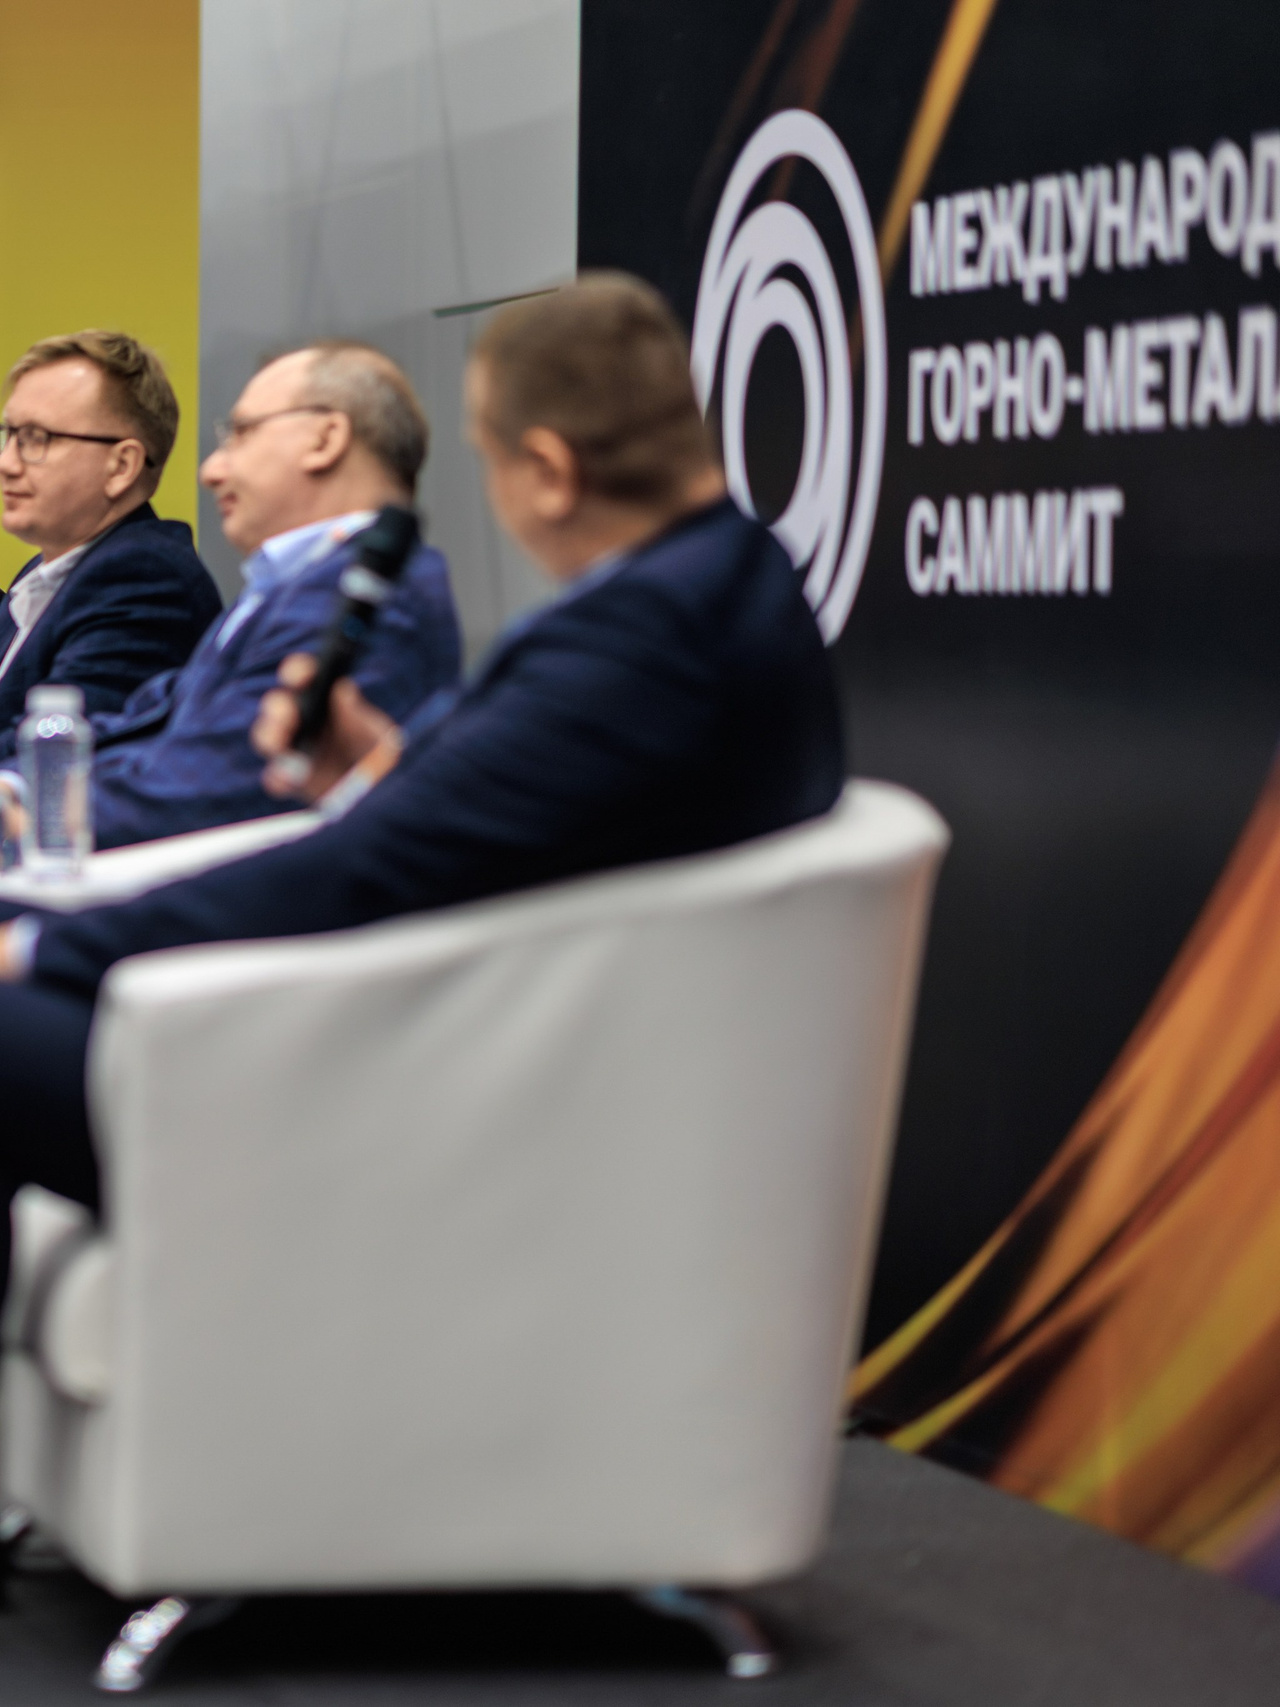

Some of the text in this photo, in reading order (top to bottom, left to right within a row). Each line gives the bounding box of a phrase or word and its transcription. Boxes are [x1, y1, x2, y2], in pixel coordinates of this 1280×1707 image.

[910, 129, 1280, 302] МЕЖДУНАРОД
[907, 306, 1280, 447] ГОРНО-МЕТАЛ
[904, 484, 1124, 598] САММИТ
